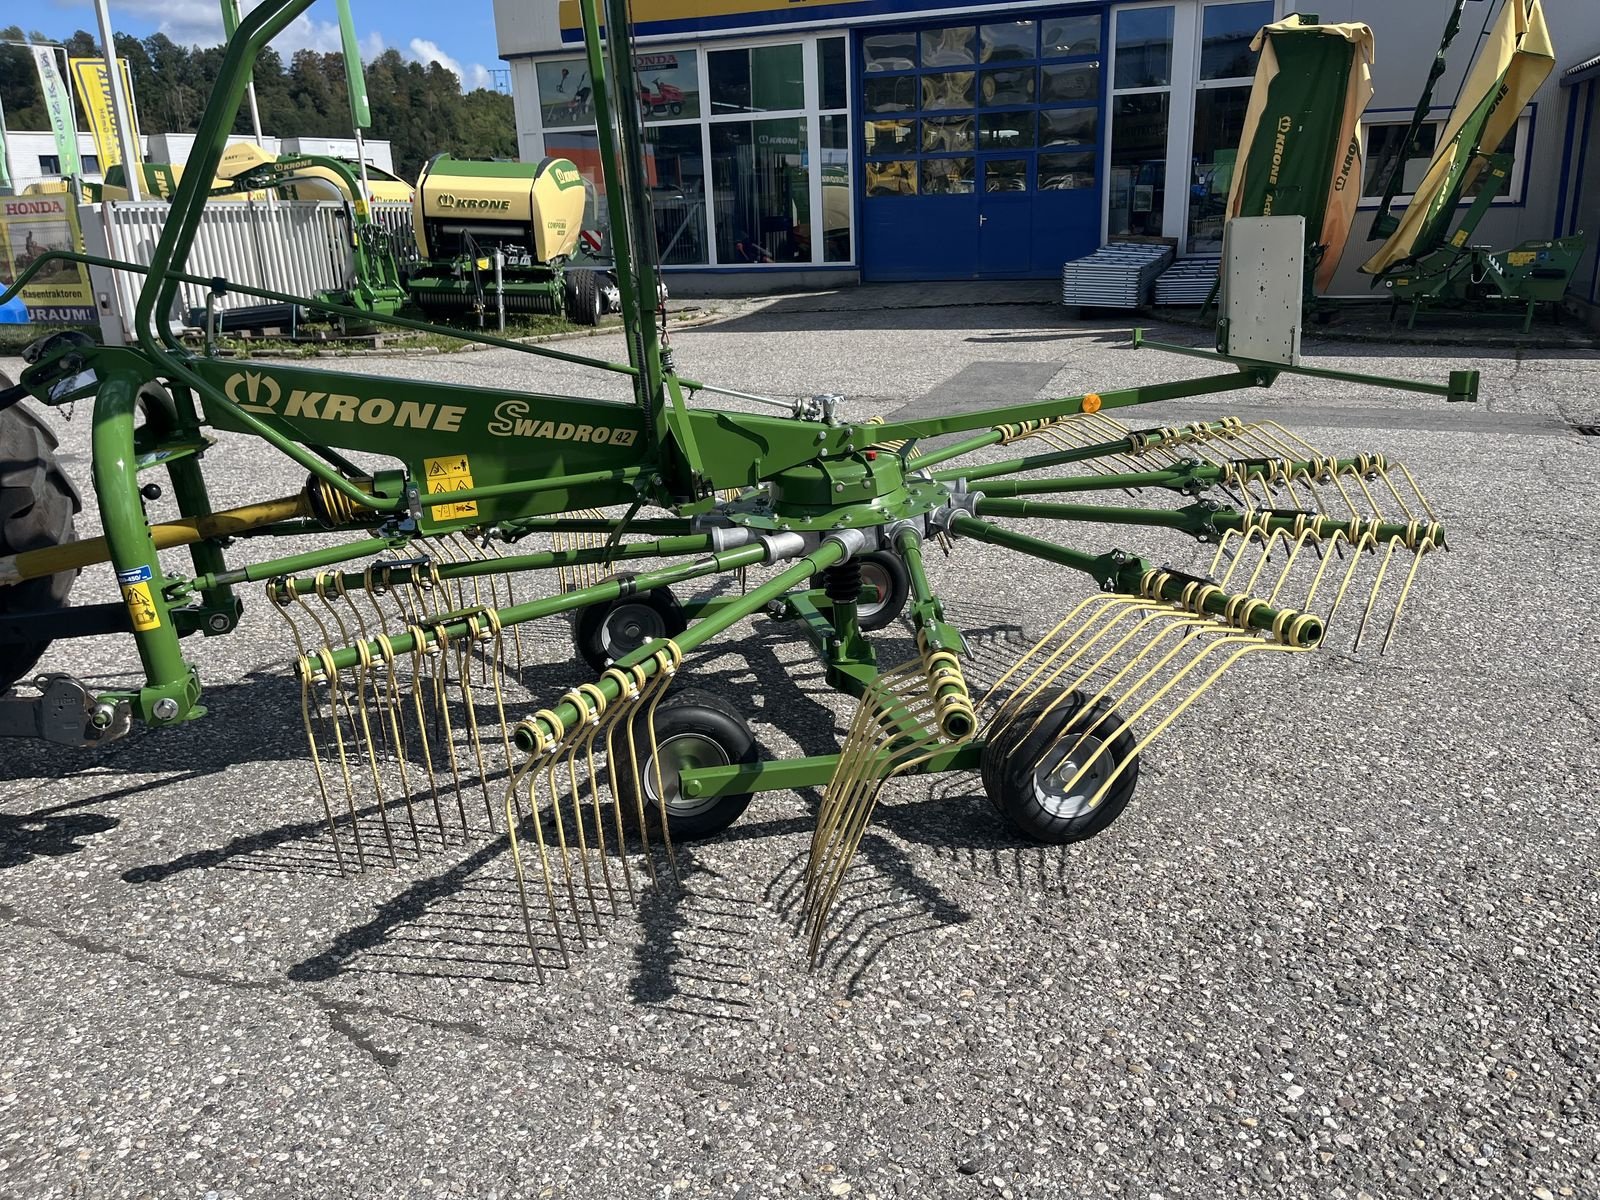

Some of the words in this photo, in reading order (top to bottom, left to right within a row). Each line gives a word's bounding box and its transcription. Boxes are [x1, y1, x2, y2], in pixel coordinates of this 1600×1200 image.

[637, 54, 678, 66] ONDA
[1269, 132, 1286, 185] KRONE
[284, 160, 312, 170] KRONE
[6, 201, 63, 215] HONDA
[455, 199, 510, 211] KRONE
[22, 289, 82, 299] Rasentraktoren
[284, 390, 467, 433] KRONE
[612, 429, 638, 447] 42
